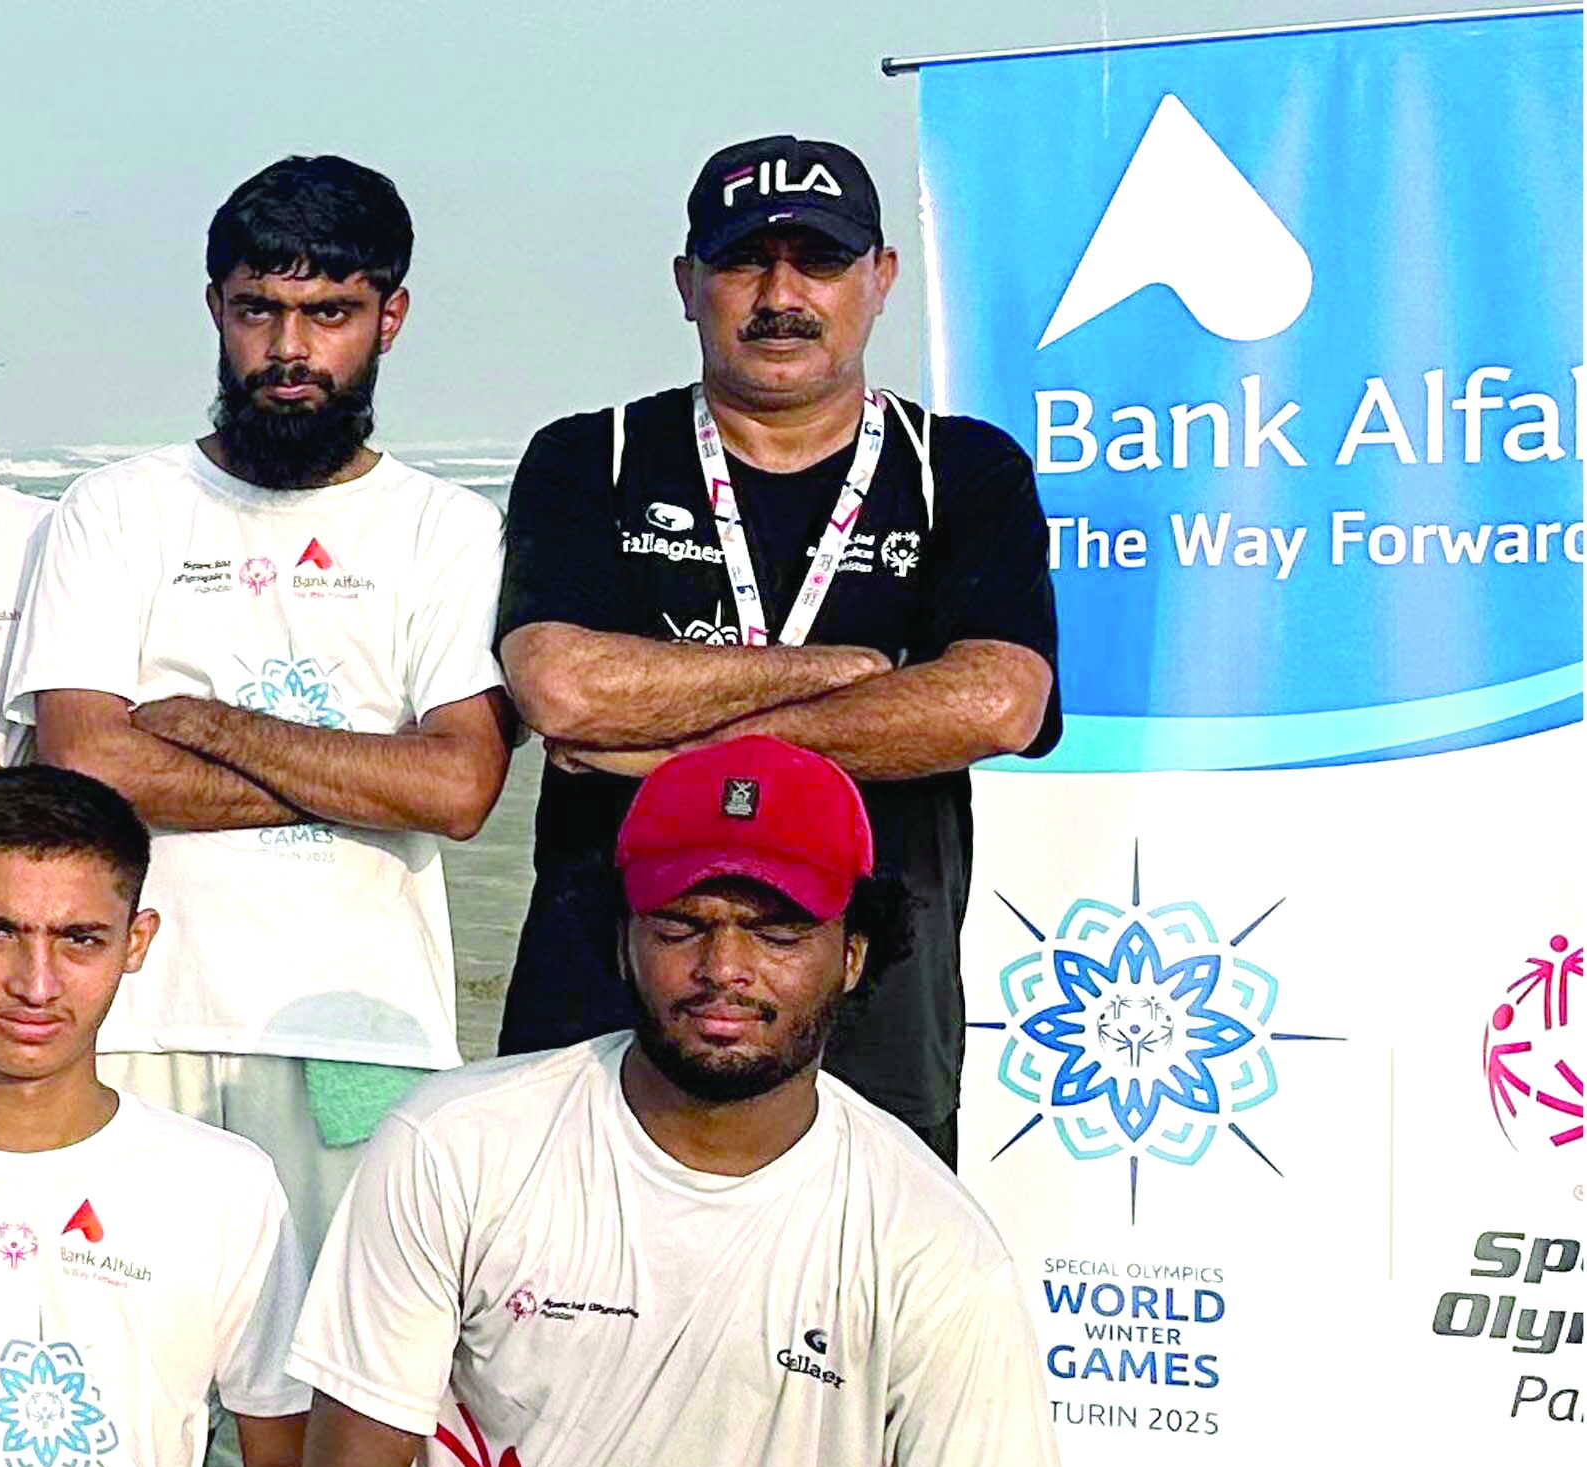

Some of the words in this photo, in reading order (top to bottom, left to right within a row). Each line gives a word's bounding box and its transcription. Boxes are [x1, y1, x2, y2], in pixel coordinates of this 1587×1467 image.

[723, 159, 843, 207] FILA
[1034, 373, 1308, 474] Bank
[622, 531, 726, 566] allagher
[1045, 516, 1148, 571] The
[1169, 511, 1308, 580] Way
[1044, 1256, 1120, 1277] SPECIAL
[1127, 1263, 1224, 1284] OLYMPICS
[1042, 1279, 1226, 1323] WORLD
[1084, 1323, 1182, 1346] WINTER
[1046, 1344, 1220, 1390] GAMES
[1049, 1400, 1137, 1429] TURIN
[1148, 1407, 1219, 1437] 2025
